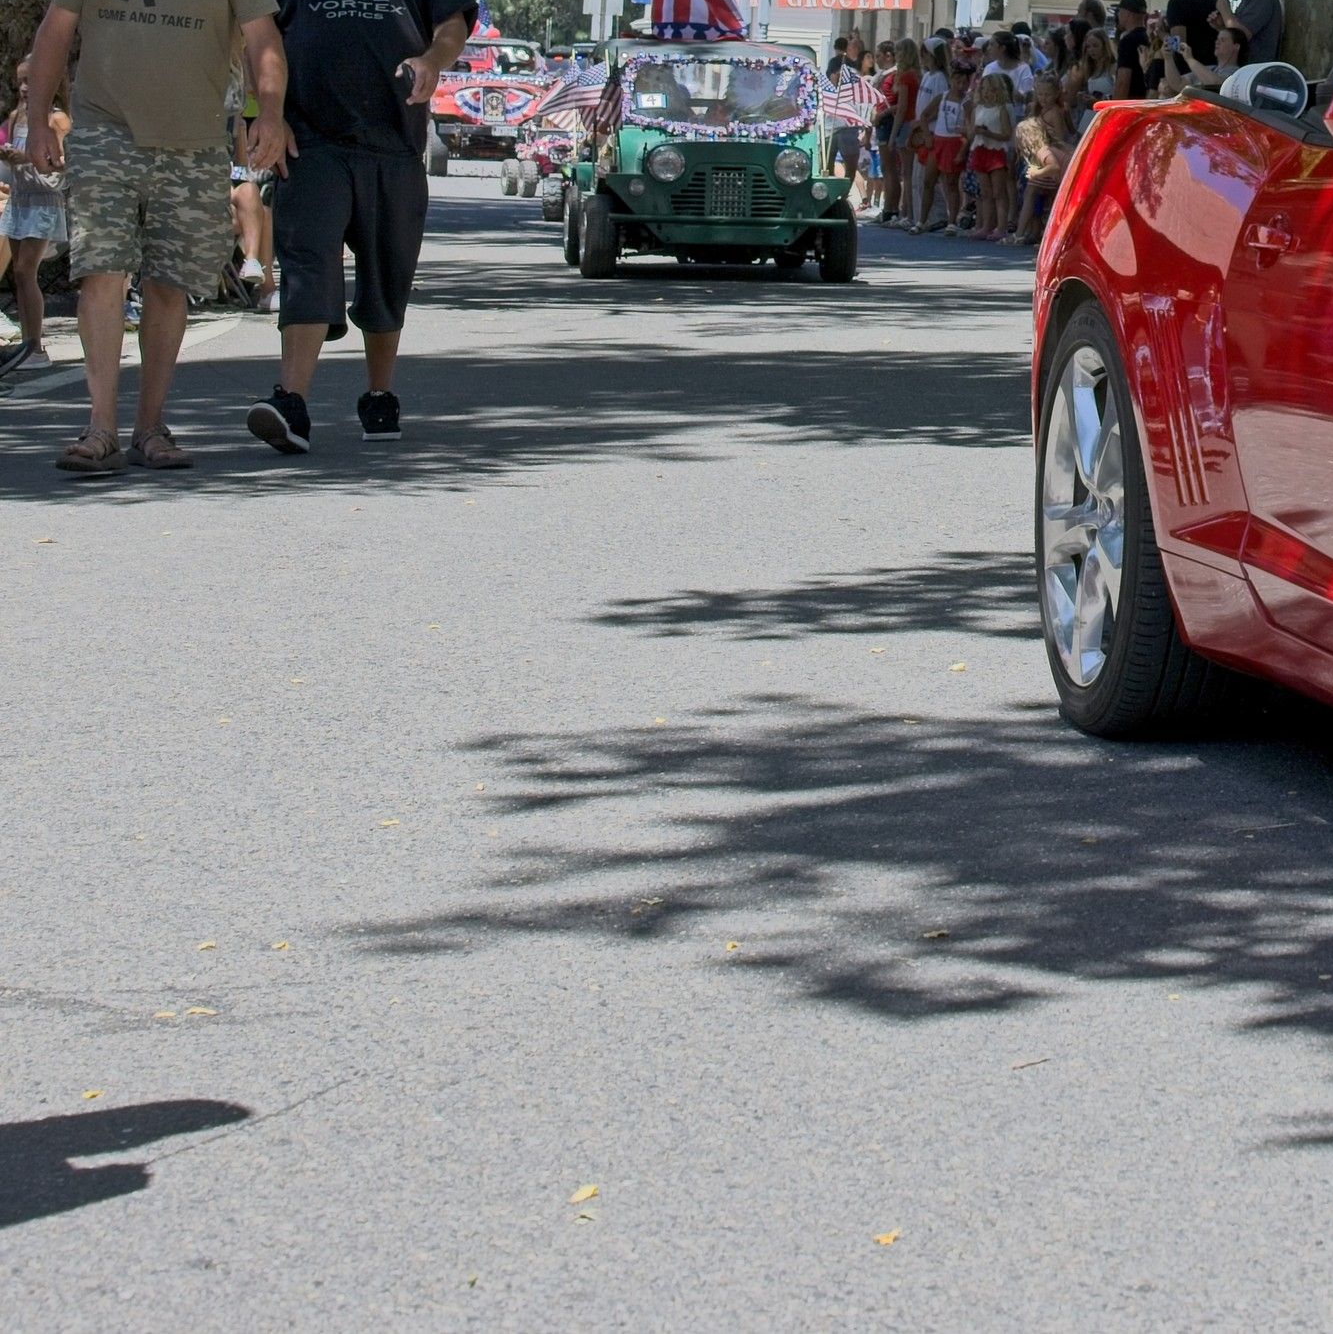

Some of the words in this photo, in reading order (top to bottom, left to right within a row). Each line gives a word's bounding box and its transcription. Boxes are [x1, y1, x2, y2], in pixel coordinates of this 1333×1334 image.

[98, 8, 126, 22] COME
[129, 11, 156, 24] AND
[161, 14, 192, 29] TAKE
[194, 18, 205, 30] IT
[326, 10, 384, 20] OPTICS
[646, 95, 657, 106] 4
